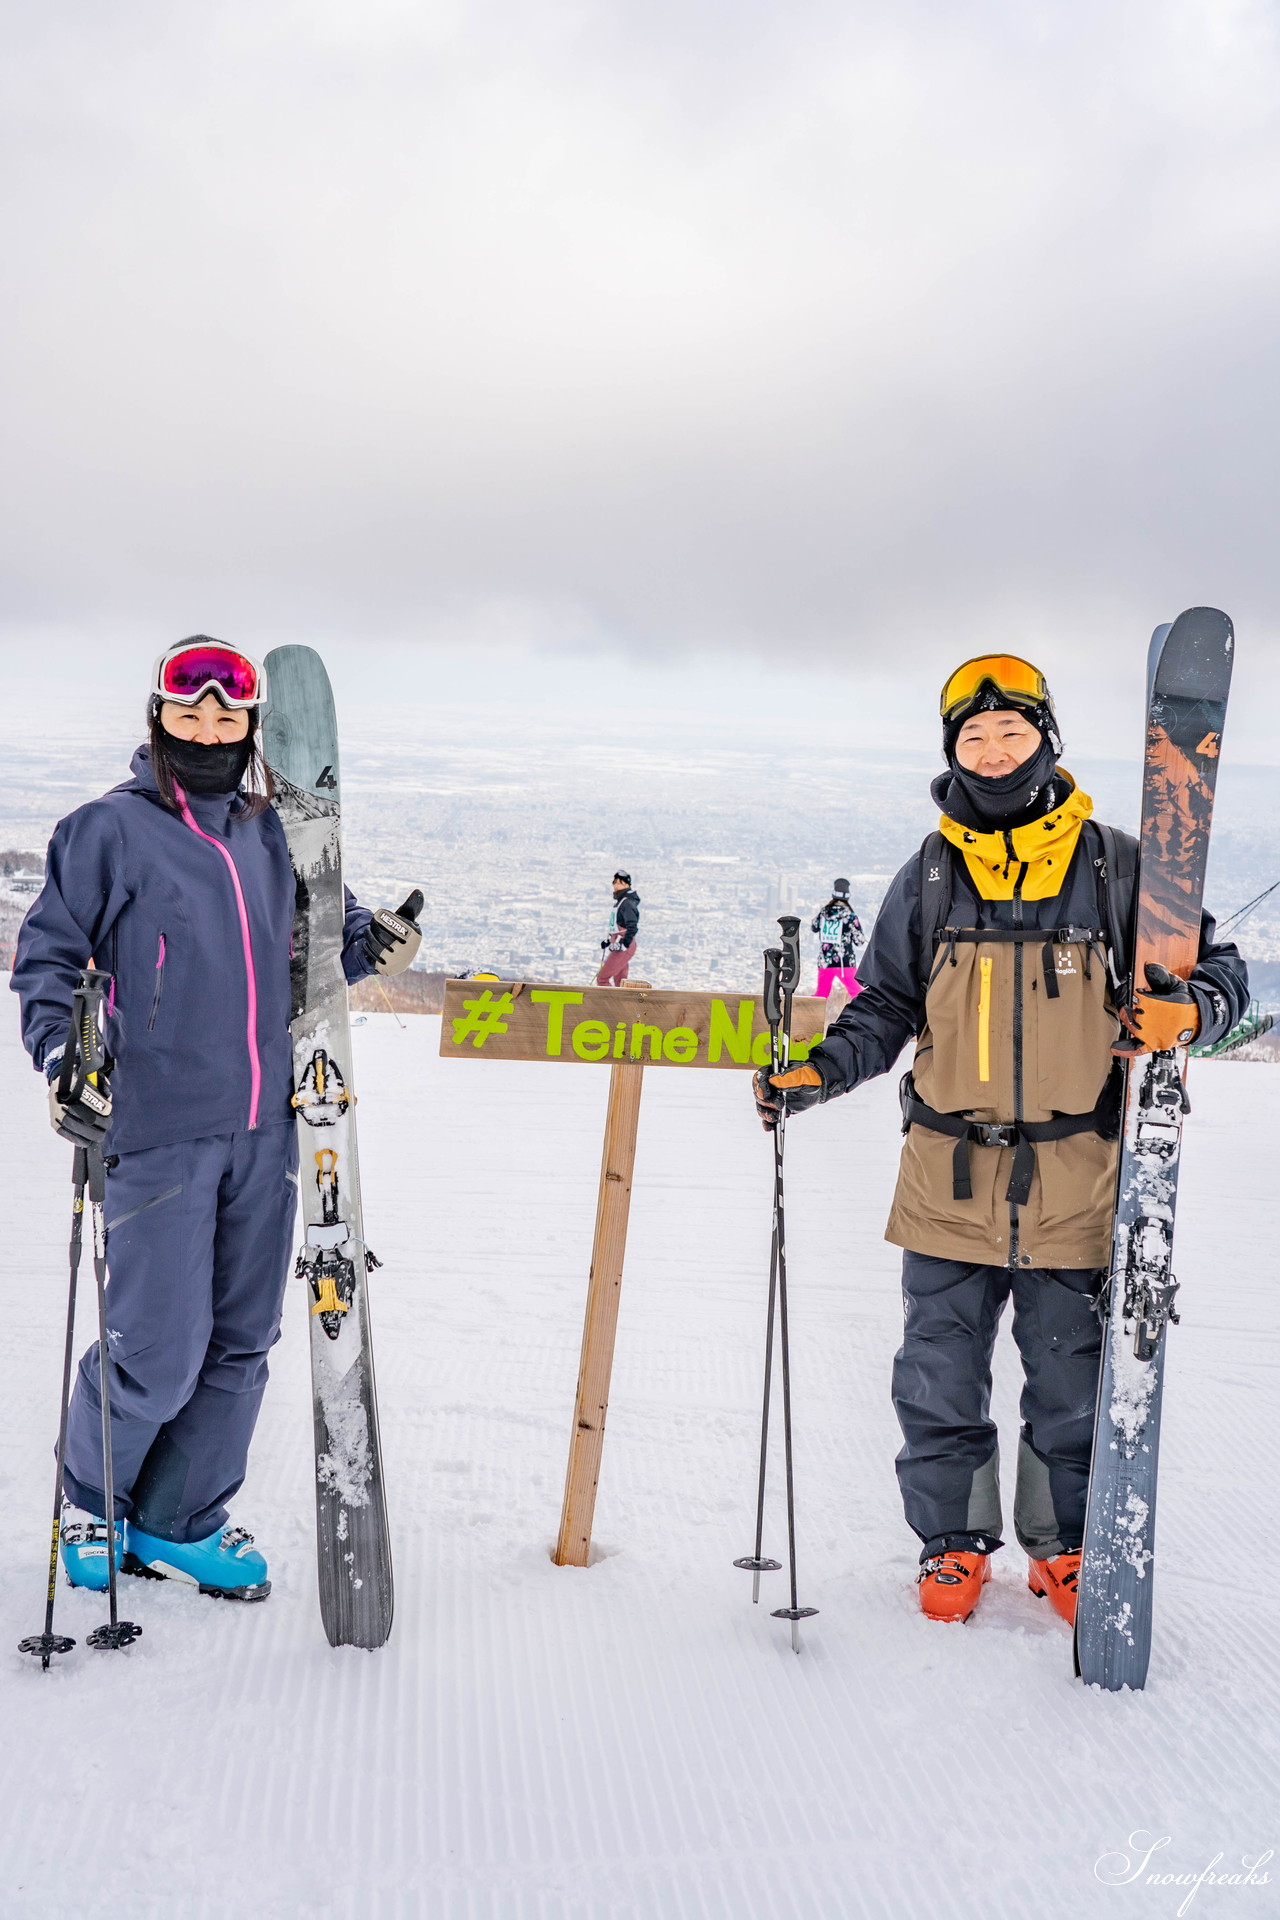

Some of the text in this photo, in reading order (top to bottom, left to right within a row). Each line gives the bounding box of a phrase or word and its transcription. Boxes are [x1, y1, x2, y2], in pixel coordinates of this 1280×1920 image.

[1196, 731, 1219, 758] 4
[316, 765, 337, 789] 4
[380, 912, 407, 936] HESTRA
[82, 1089, 105, 1111] ESTRA
